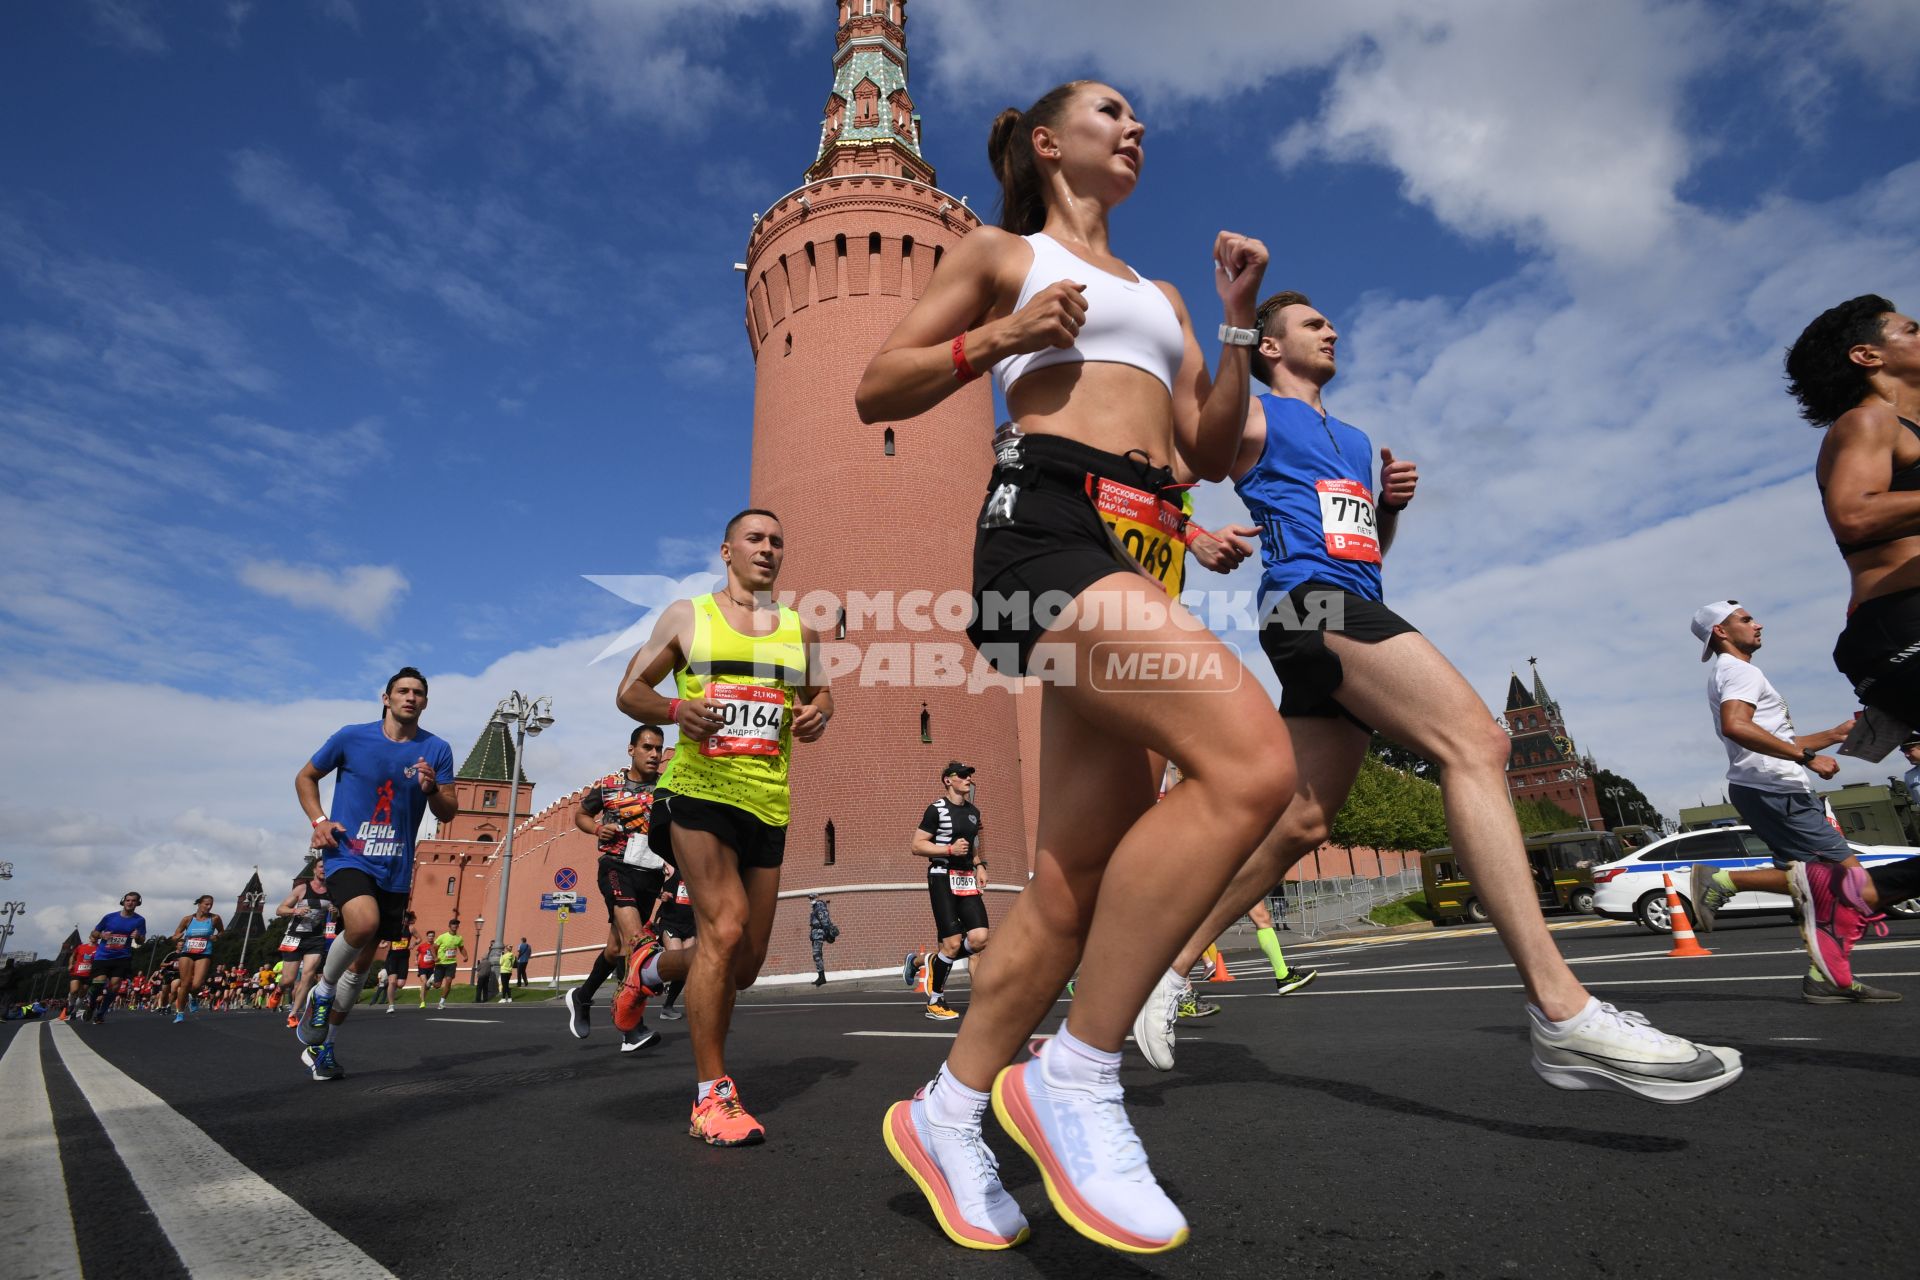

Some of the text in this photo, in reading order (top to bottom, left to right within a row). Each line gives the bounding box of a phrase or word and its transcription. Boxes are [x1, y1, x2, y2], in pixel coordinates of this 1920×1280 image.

[1101, 482, 1155, 506] МОСКОВСКИЙ
[1098, 500, 1138, 518] МАРАФОН
[1106, 521, 1172, 582] 069
[752, 690, 766, 698] 21,1
[727, 728, 760, 737] АНДРЕЙ
[951, 876, 974, 887] 10569
